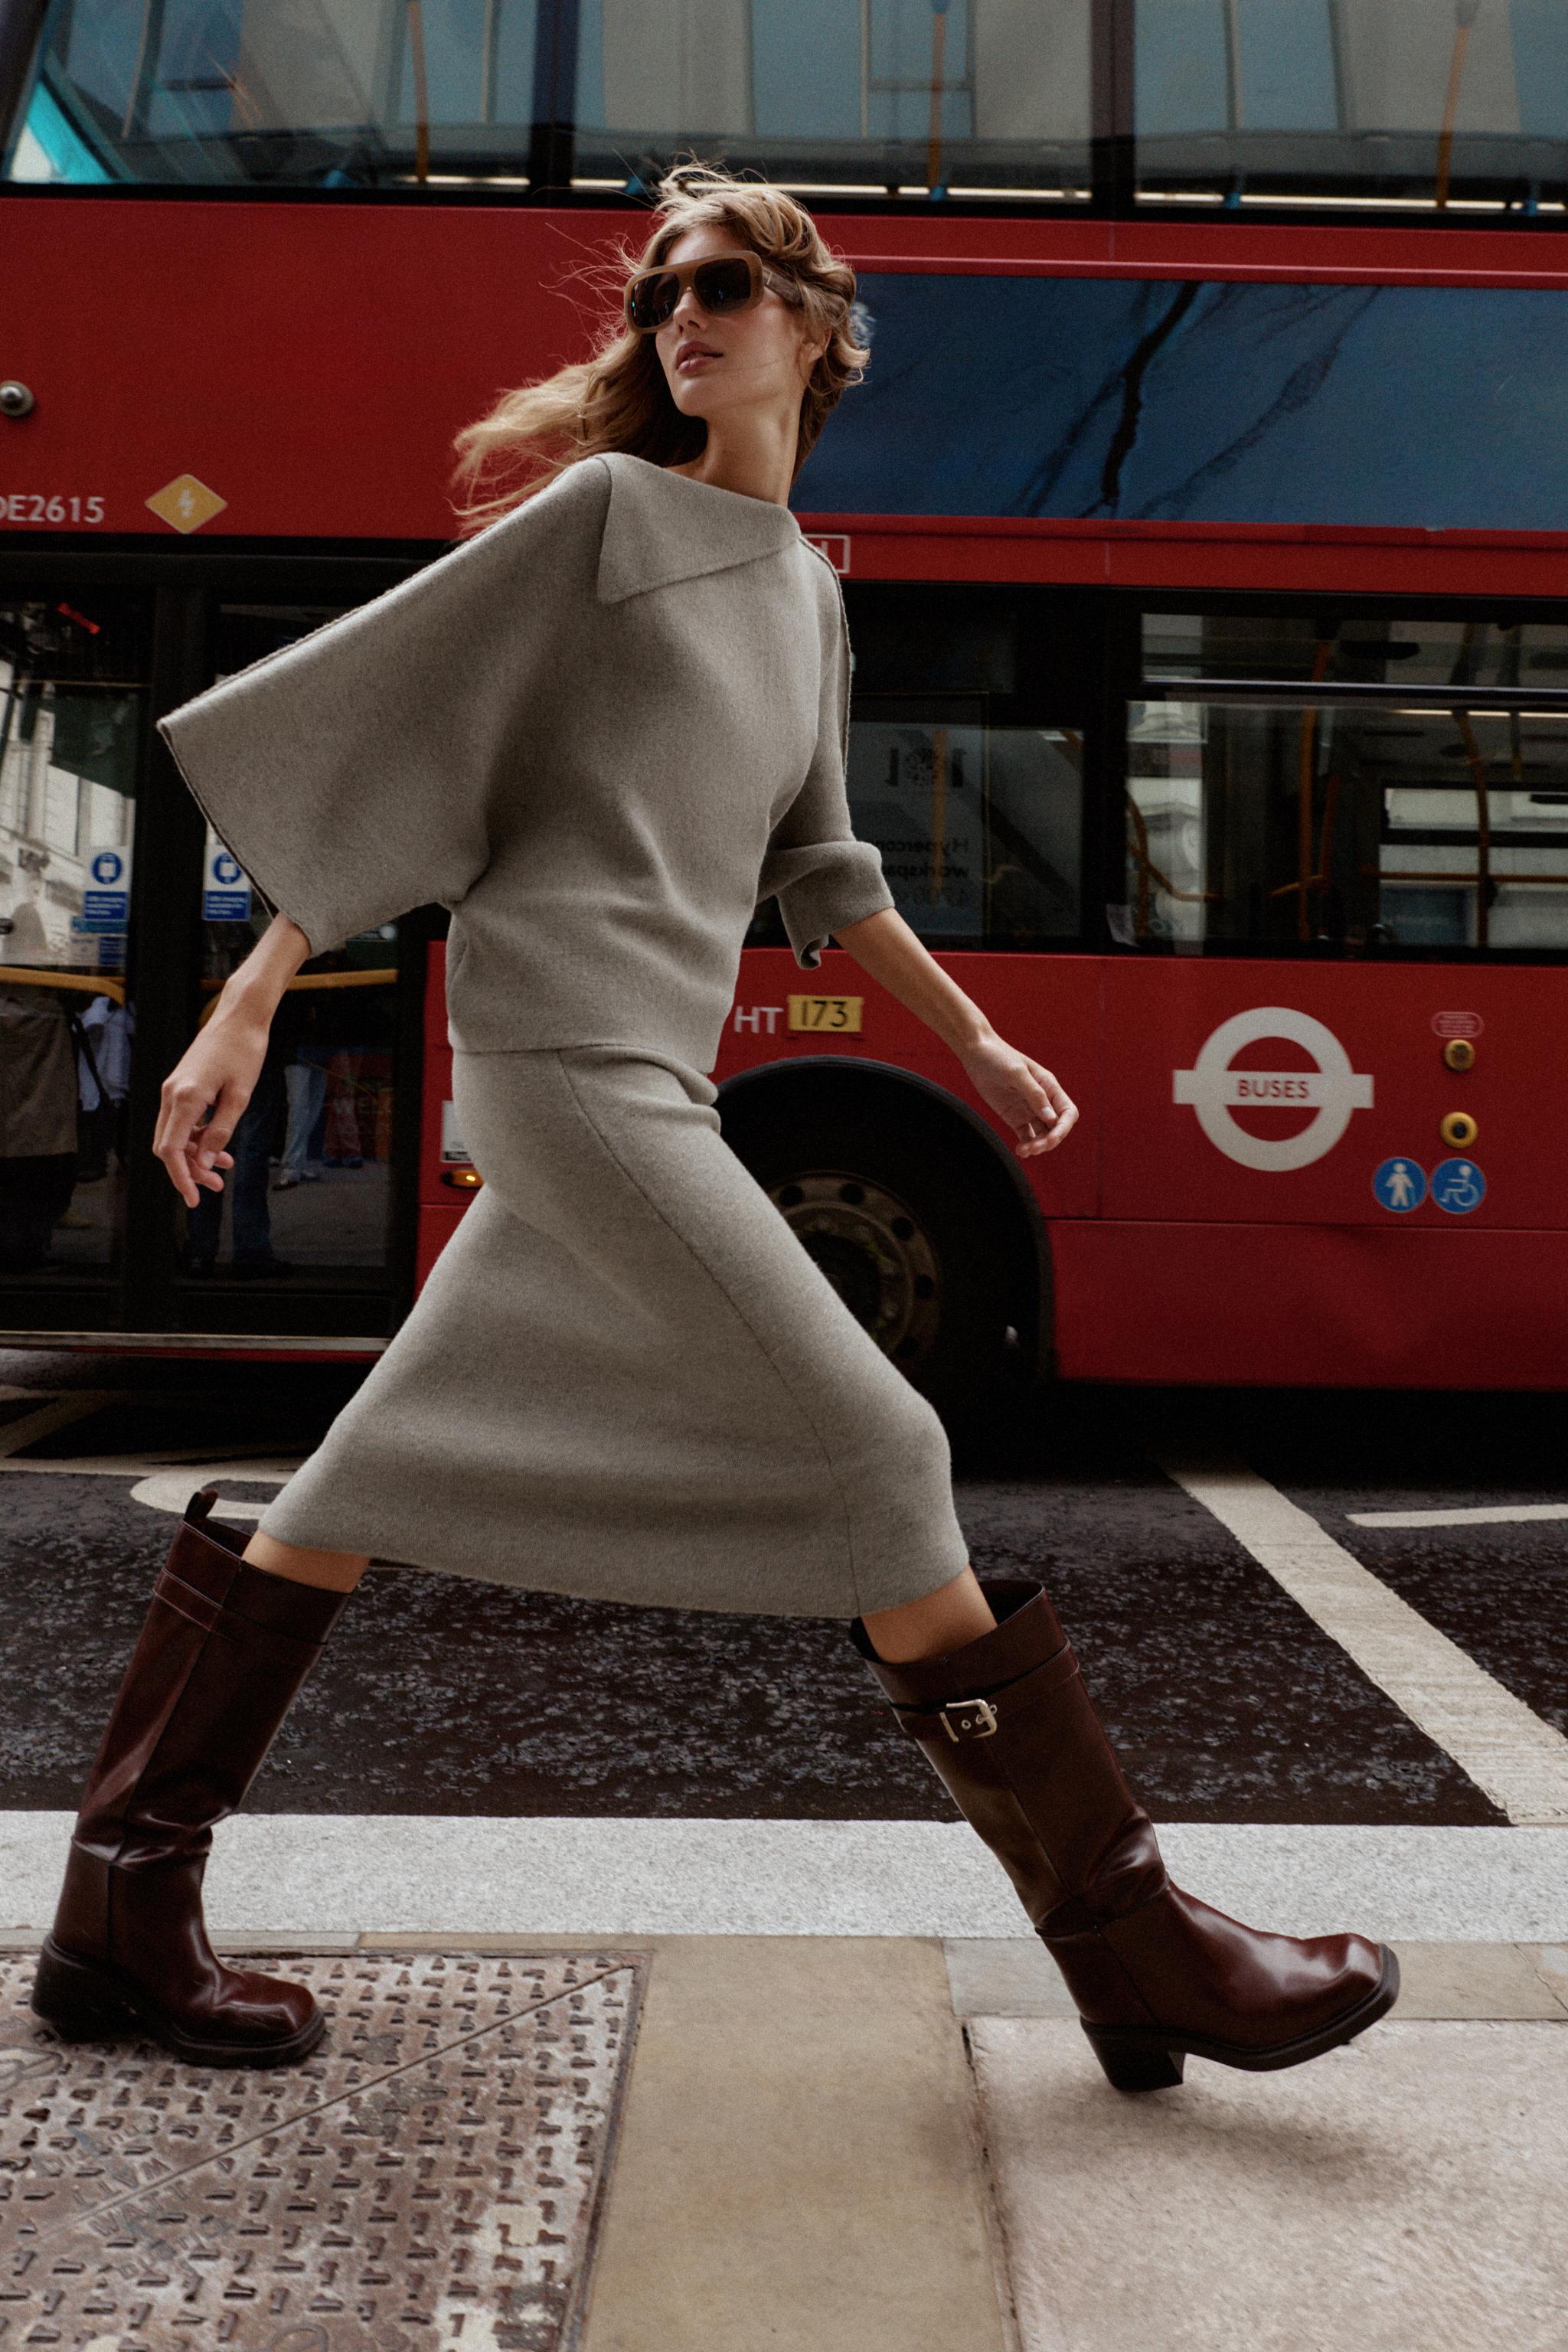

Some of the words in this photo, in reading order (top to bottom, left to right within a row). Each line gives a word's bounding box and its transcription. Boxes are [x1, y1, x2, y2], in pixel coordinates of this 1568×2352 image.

[733, 1005, 784, 1034] HT
[801, 999, 848, 1027] 173
[1237, 1079, 1310, 1099] BUSES
